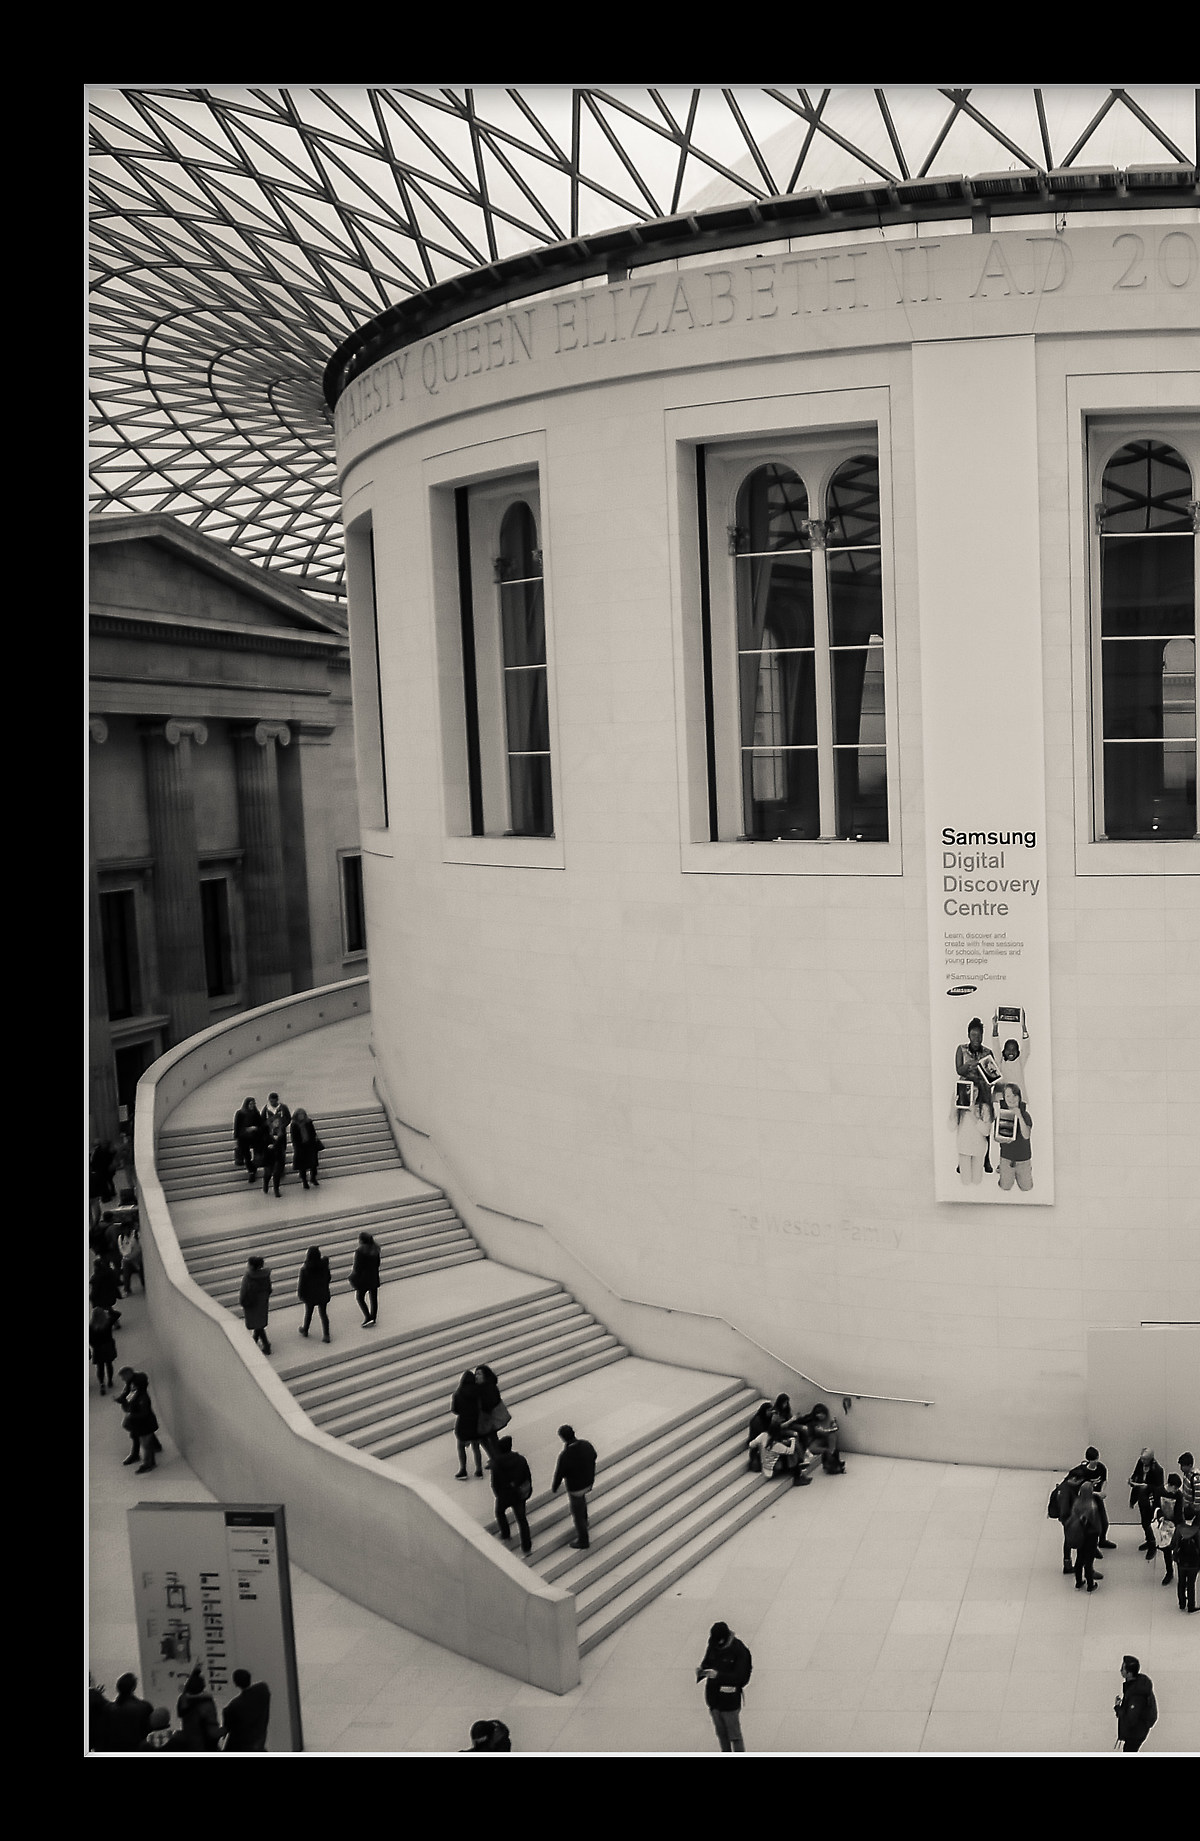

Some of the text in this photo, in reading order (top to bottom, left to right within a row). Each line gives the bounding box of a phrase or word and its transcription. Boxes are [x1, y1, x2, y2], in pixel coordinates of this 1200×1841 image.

[340, 352, 409, 436] AJESTY
[422, 309, 535, 395] QUEEN
[552, 252, 869, 354] ELIZABETH
[895, 244, 942, 304] II
[969, 237, 1073, 299] AD
[941, 827, 1036, 849] Samsung
[943, 851, 1005, 872] Digital
[943, 875, 1040, 896] Discovery
[943, 898, 1009, 916] Centre
